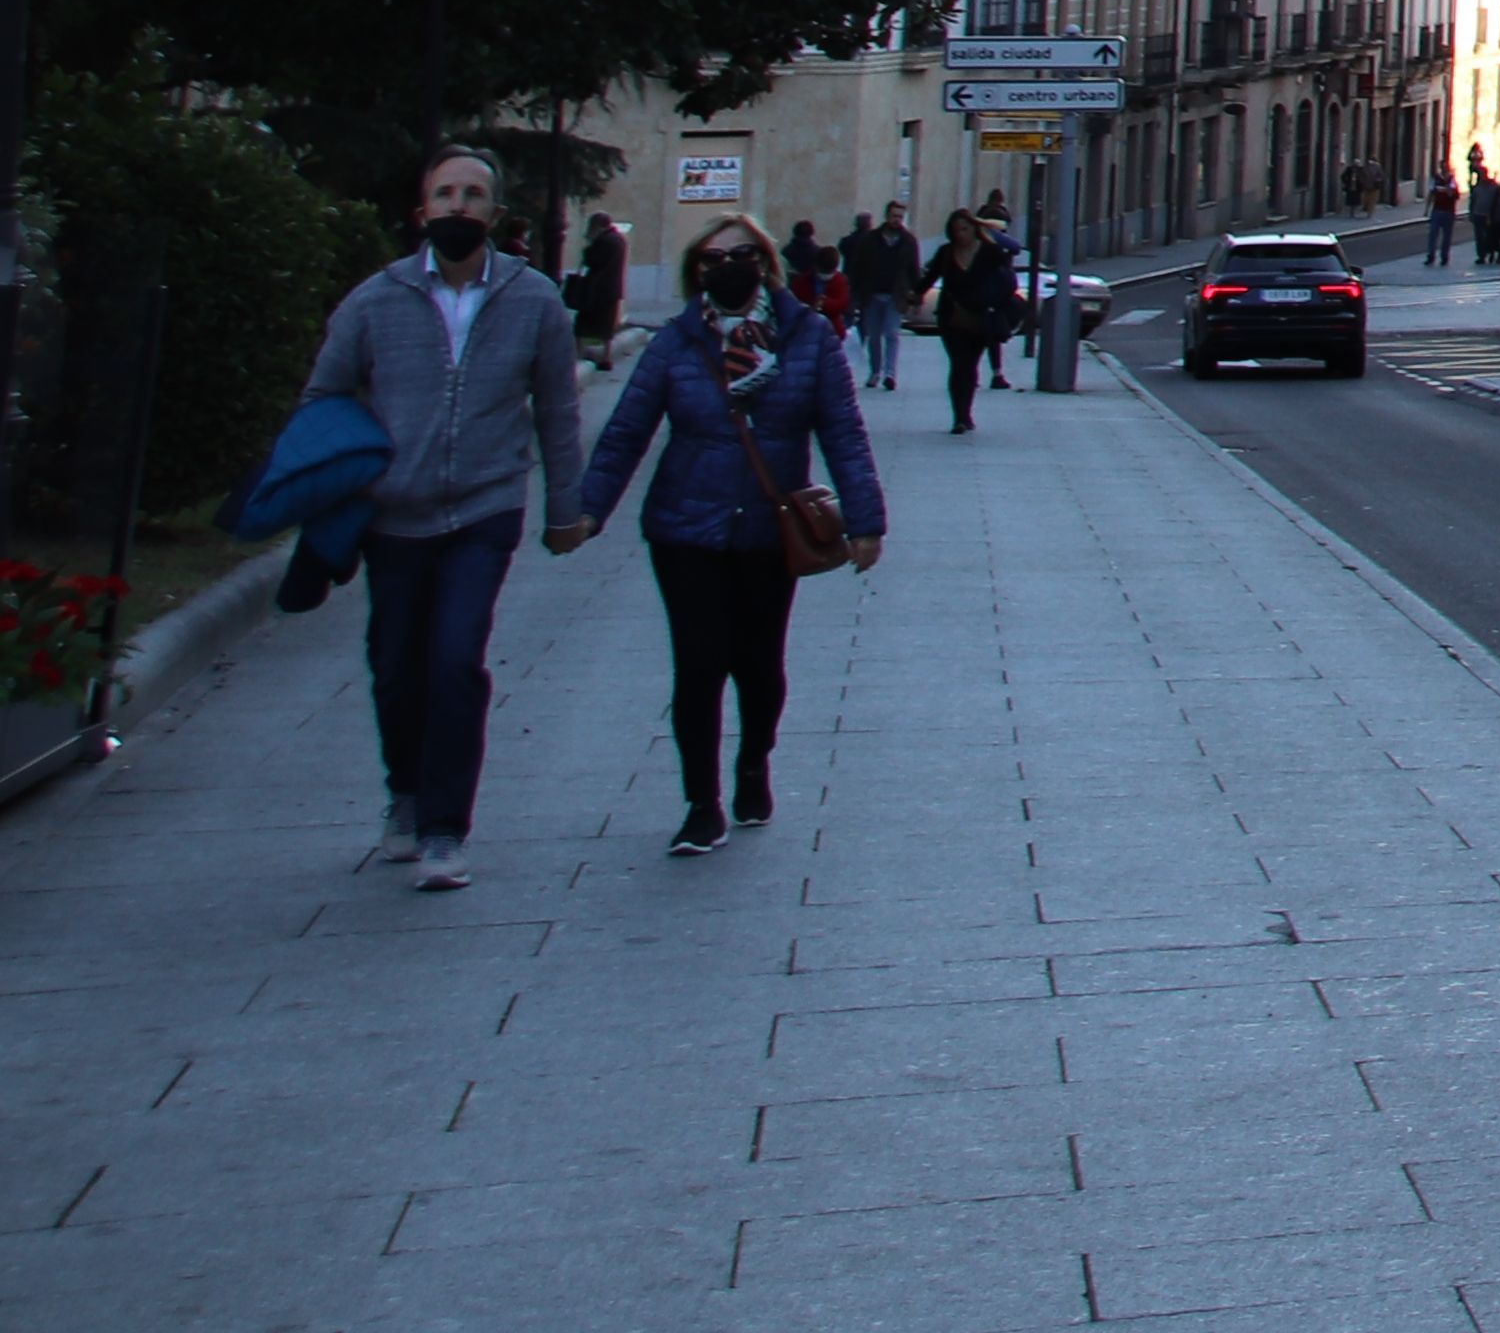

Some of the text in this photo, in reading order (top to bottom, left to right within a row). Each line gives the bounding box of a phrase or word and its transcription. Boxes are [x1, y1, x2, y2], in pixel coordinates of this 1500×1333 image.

[951, 47, 1052, 60] salida ciudad
[1008, 88, 1116, 102] centro urbano
